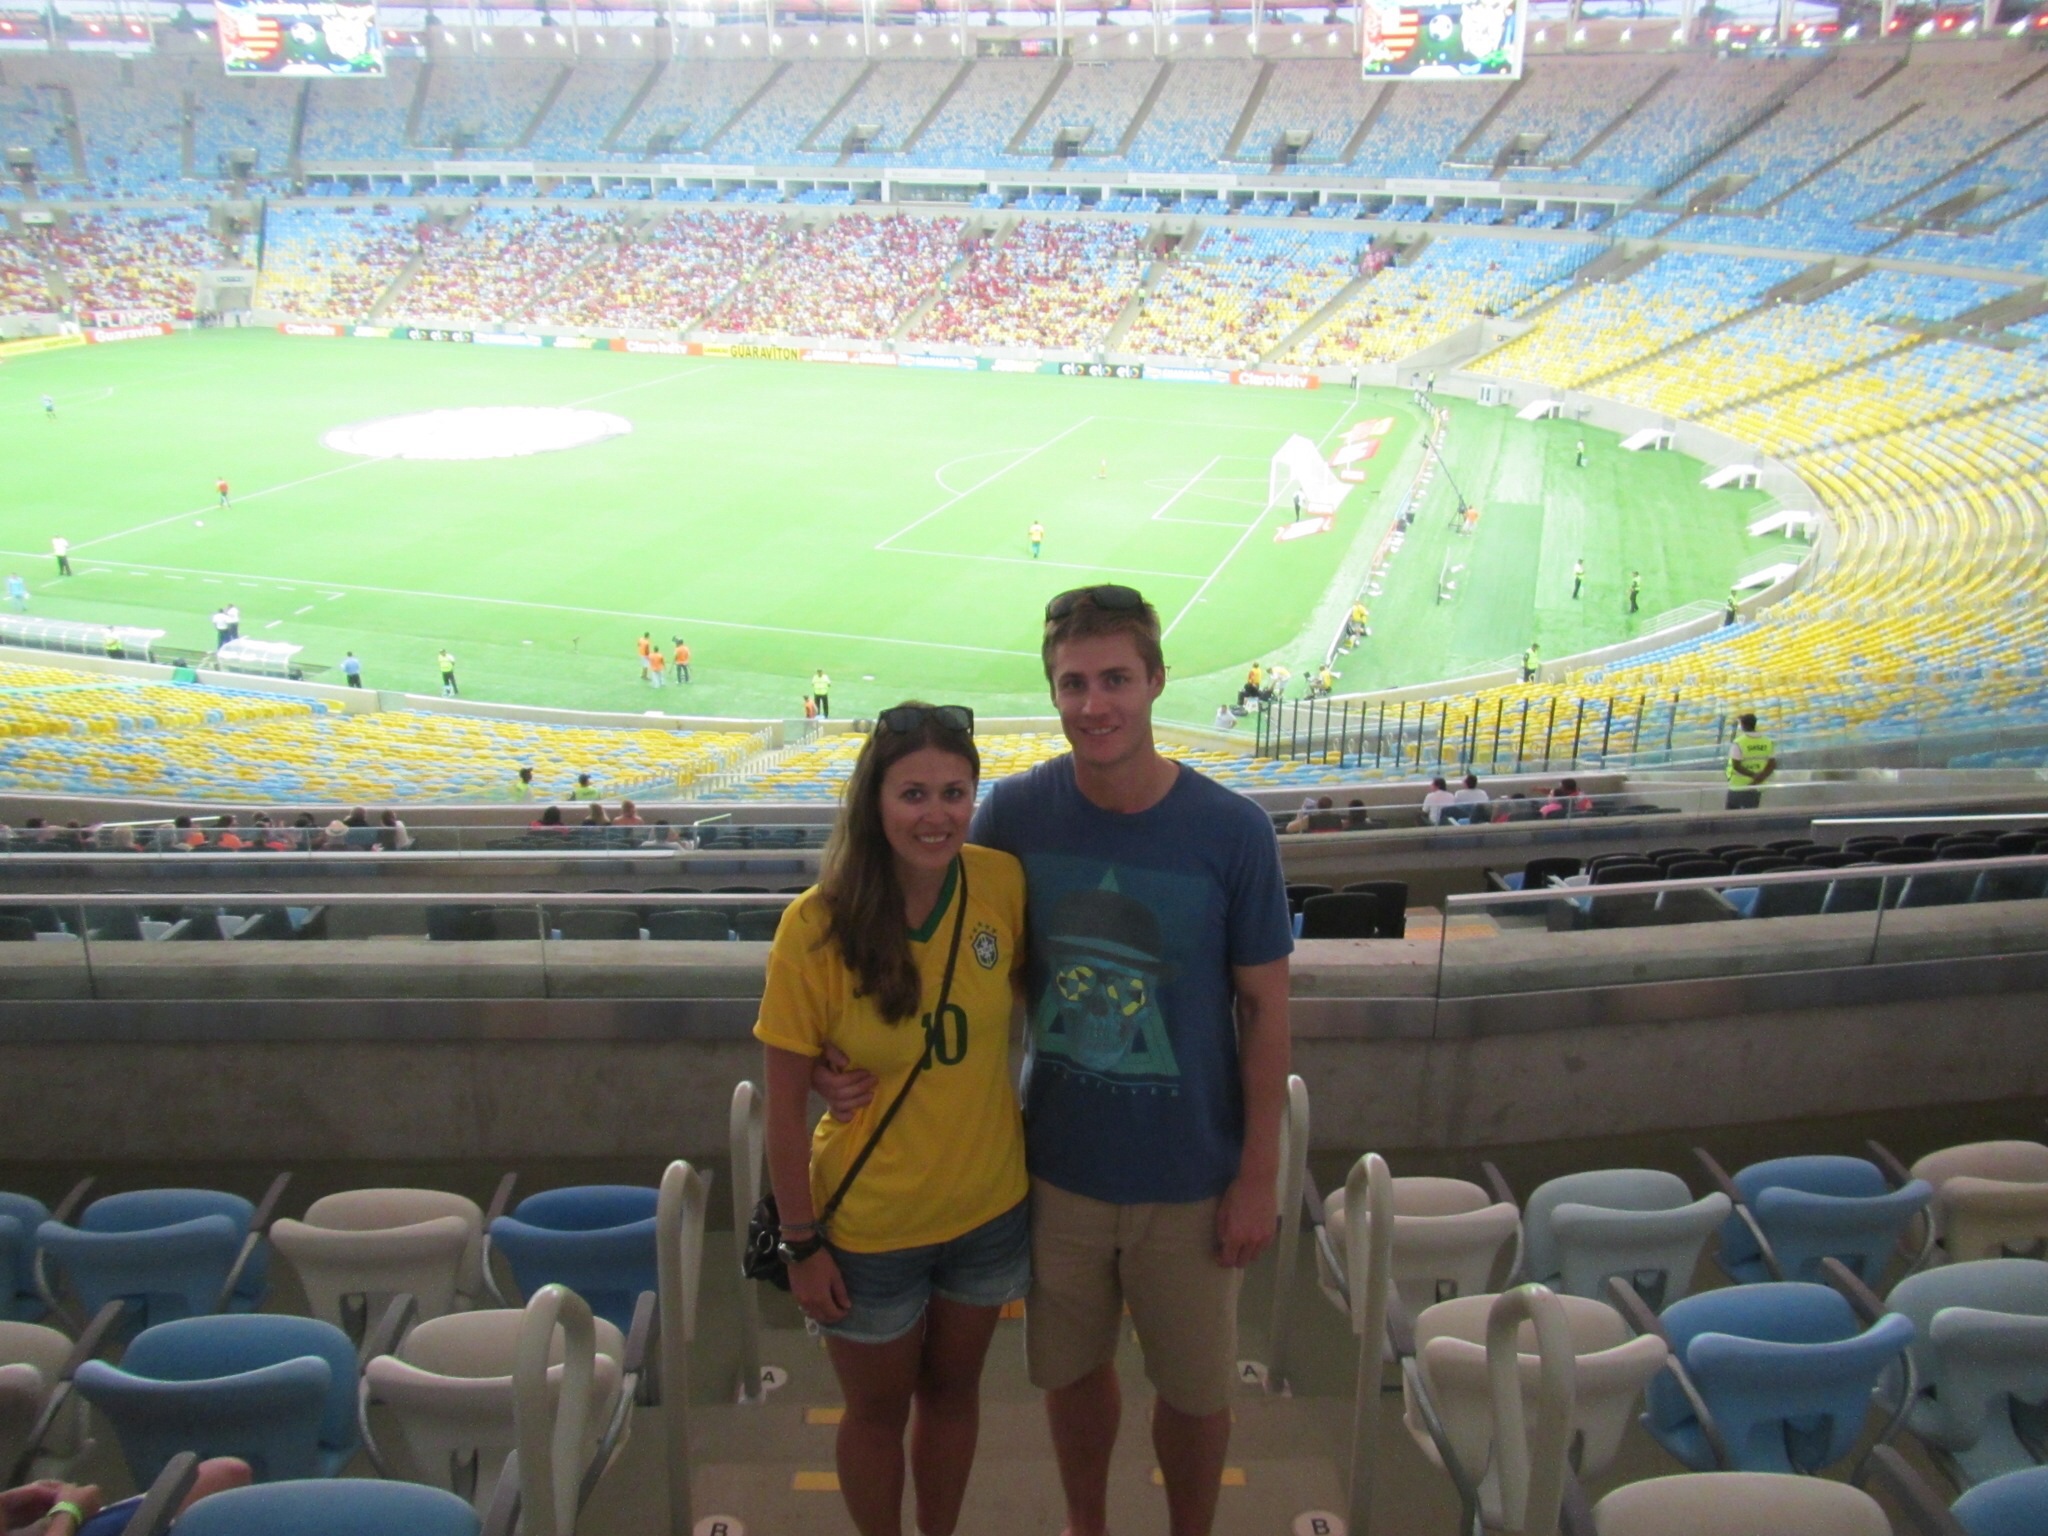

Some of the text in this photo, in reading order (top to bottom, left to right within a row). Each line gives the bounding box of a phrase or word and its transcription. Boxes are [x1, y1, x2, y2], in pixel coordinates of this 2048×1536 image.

[408, 329, 428, 341] elo
[430, 330, 449, 342] elo
[452, 331, 471, 343] elo
[730, 343, 798, 360] GUARAVITON
[1062, 362, 1139, 378] elo elo elo
[921, 1003, 967, 1070] 10
[763, 1370, 775, 1384] A
[1243, 1364, 1258, 1378] A
[710, 1522, 728, 1536] B
[1311, 1518, 1330, 1535] B
